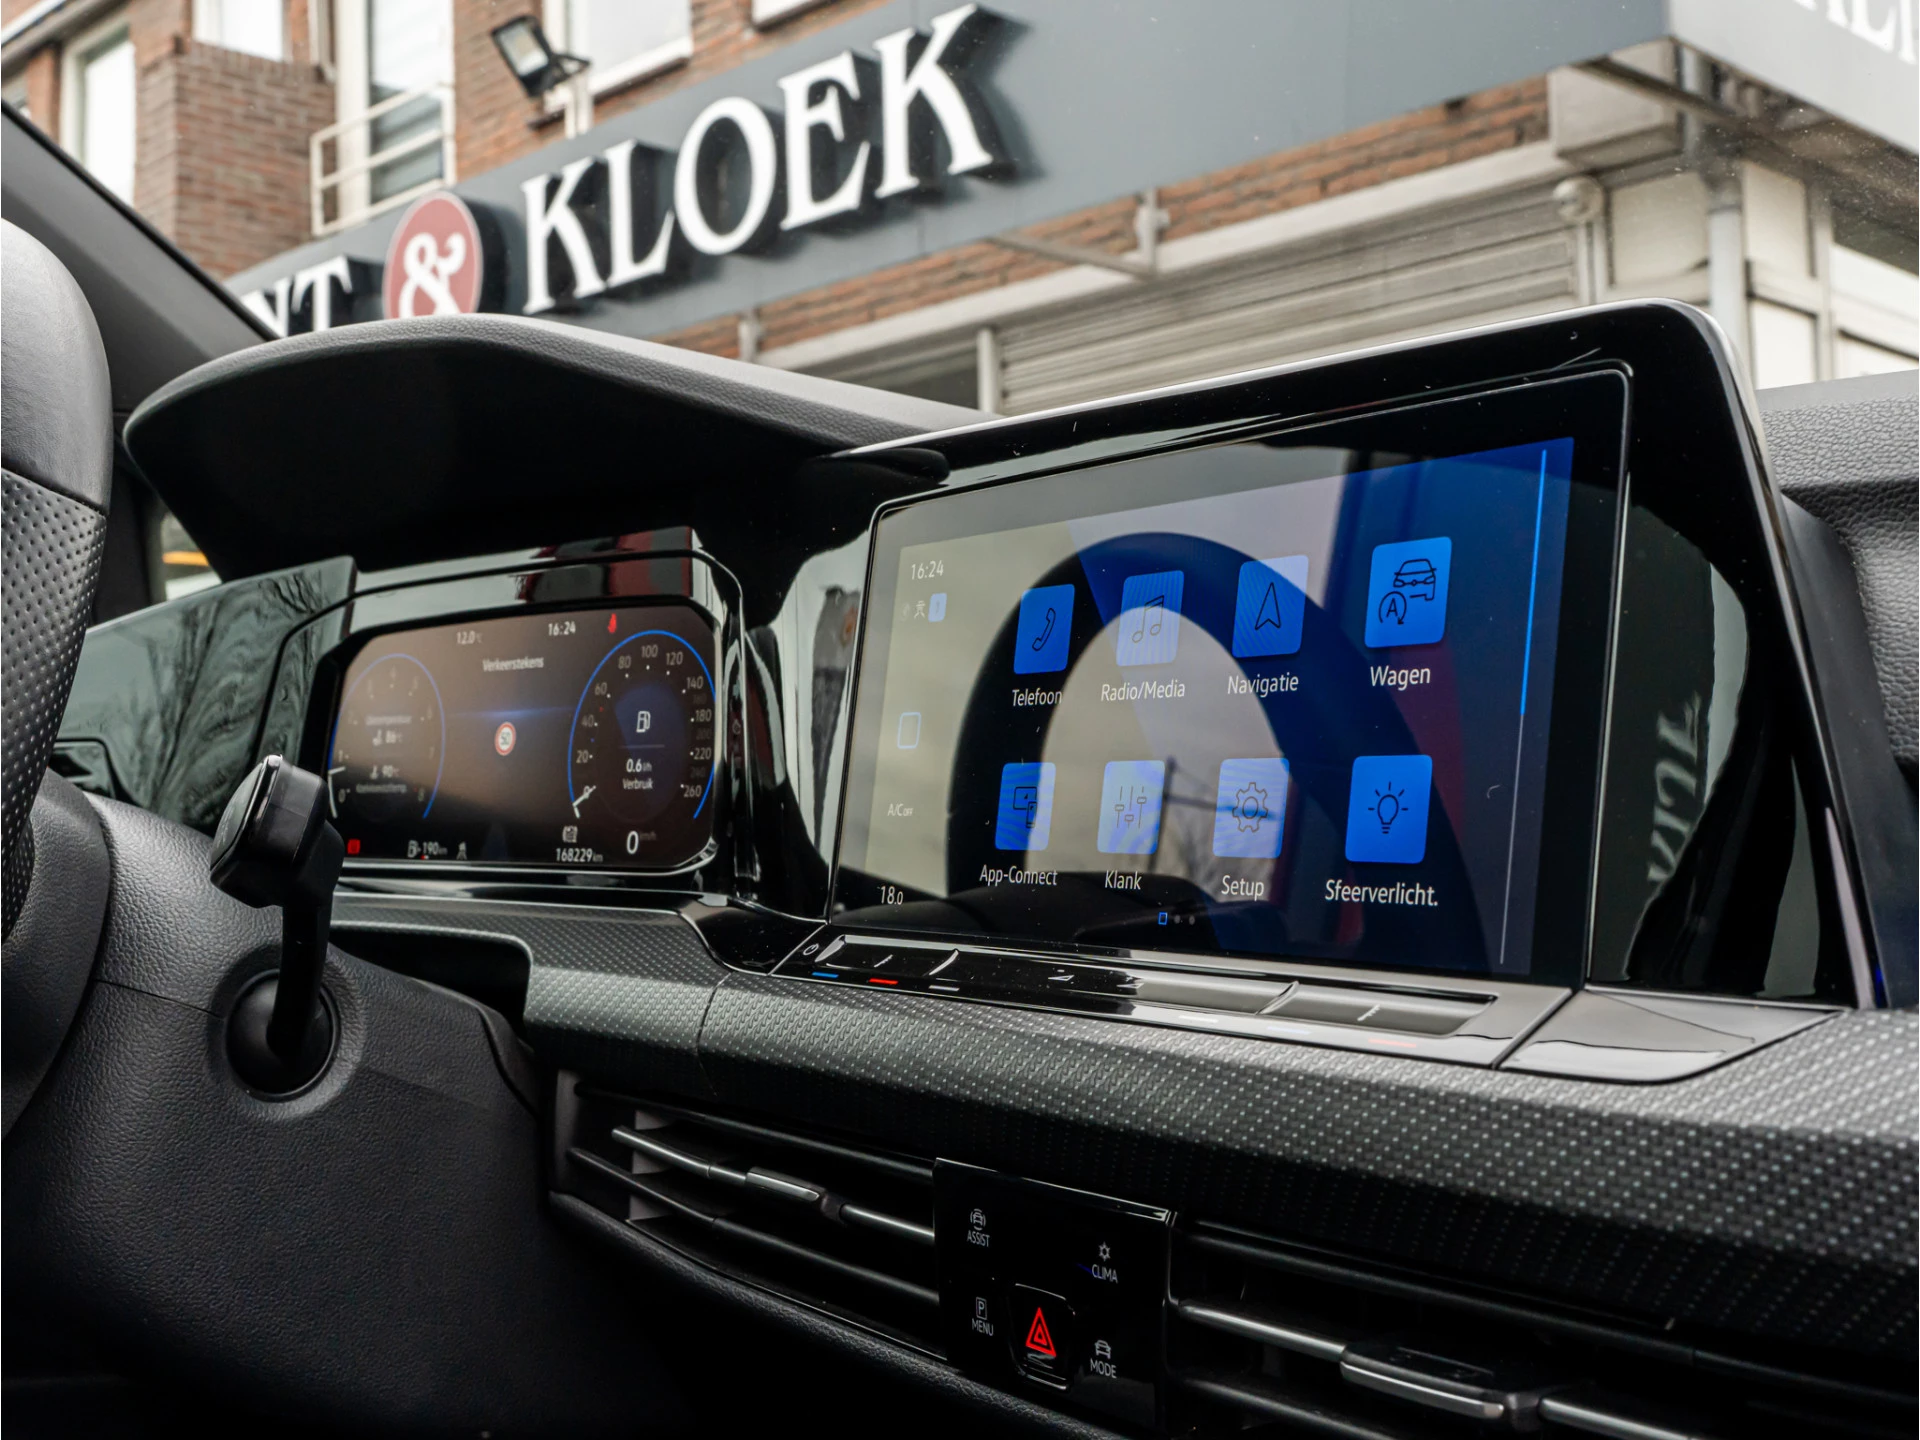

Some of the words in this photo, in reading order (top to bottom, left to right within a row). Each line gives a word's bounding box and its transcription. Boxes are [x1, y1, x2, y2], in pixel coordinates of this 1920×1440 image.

[520, 3, 993, 316] KLOEK
[911, 559, 944, 580] 16:24
[547, 621, 576, 636] 16:24
[641, 644, 659, 658] 100
[666, 651, 684, 666] 120
[482, 655, 545, 672] Verkeerstekens
[618, 655, 632, 669] 80
[687, 675, 704, 690] 140
[1227, 672, 1299, 699] Navigatie
[1370, 663, 1431, 691] Wagen
[594, 682, 608, 696] 60
[1012, 687, 1063, 708] Telefoon
[1101, 679, 1186, 702] Radio/Media
[581, 713, 595, 728] 40
[695, 708, 713, 723] 180
[576, 749, 589, 764] 20
[693, 747, 712, 761] 220
[626, 757, 643, 773] 0.6
[621, 776, 654, 791] Verbruik
[684, 784, 702, 799] 260
[626, 829, 640, 855] 0
[556, 847, 593, 862] 168229
[980, 865, 1058, 890] App-Connect
[1104, 870, 1142, 891] Klank
[880, 886, 904, 905] 18.0
[1221, 875, 1265, 900] Setup
[1325, 879, 1439, 907] Sfeerverlicht.
[967, 1230, 991, 1248] ASSIST
[1091, 1264, 1119, 1284] CLIMA
[971, 1318, 994, 1337] MENU
[1090, 1358, 1118, 1379] MODE
